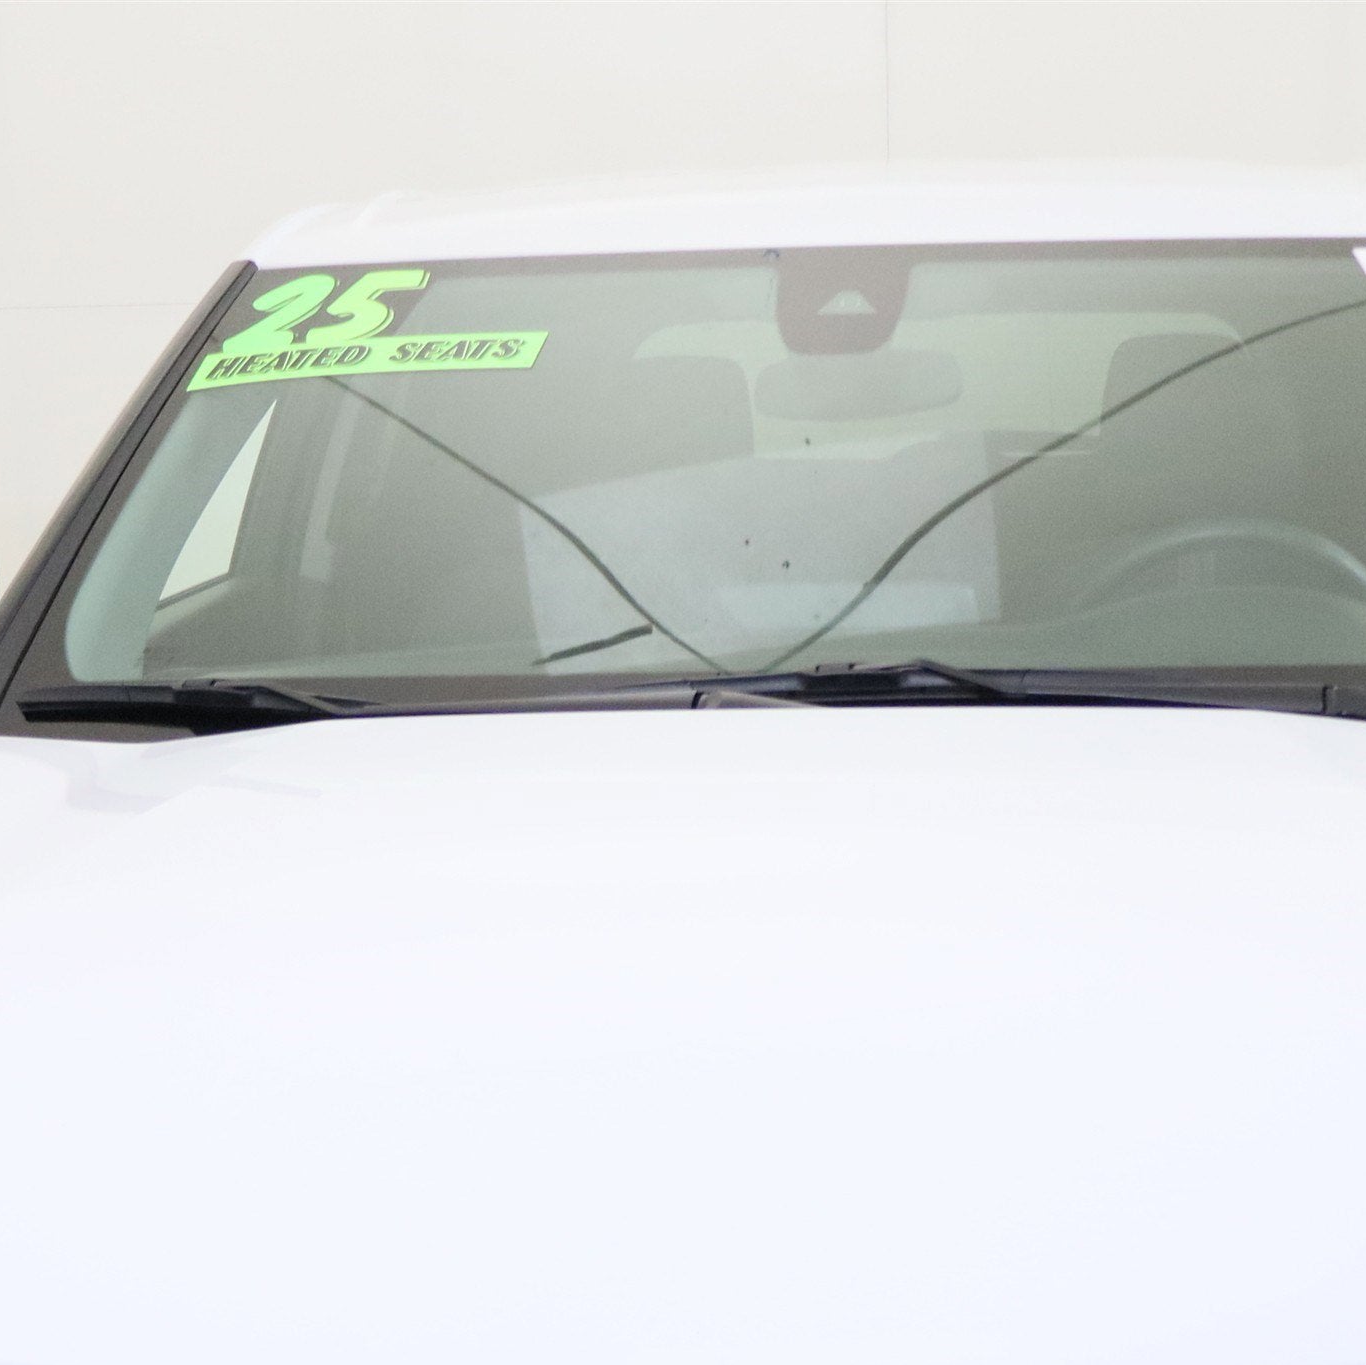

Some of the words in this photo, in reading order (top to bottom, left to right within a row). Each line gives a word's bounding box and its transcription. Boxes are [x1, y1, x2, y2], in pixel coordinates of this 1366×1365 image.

[222, 269, 432, 354] 25
[205, 344, 372, 381] HEATED
[389, 338, 527, 363] SEATS
